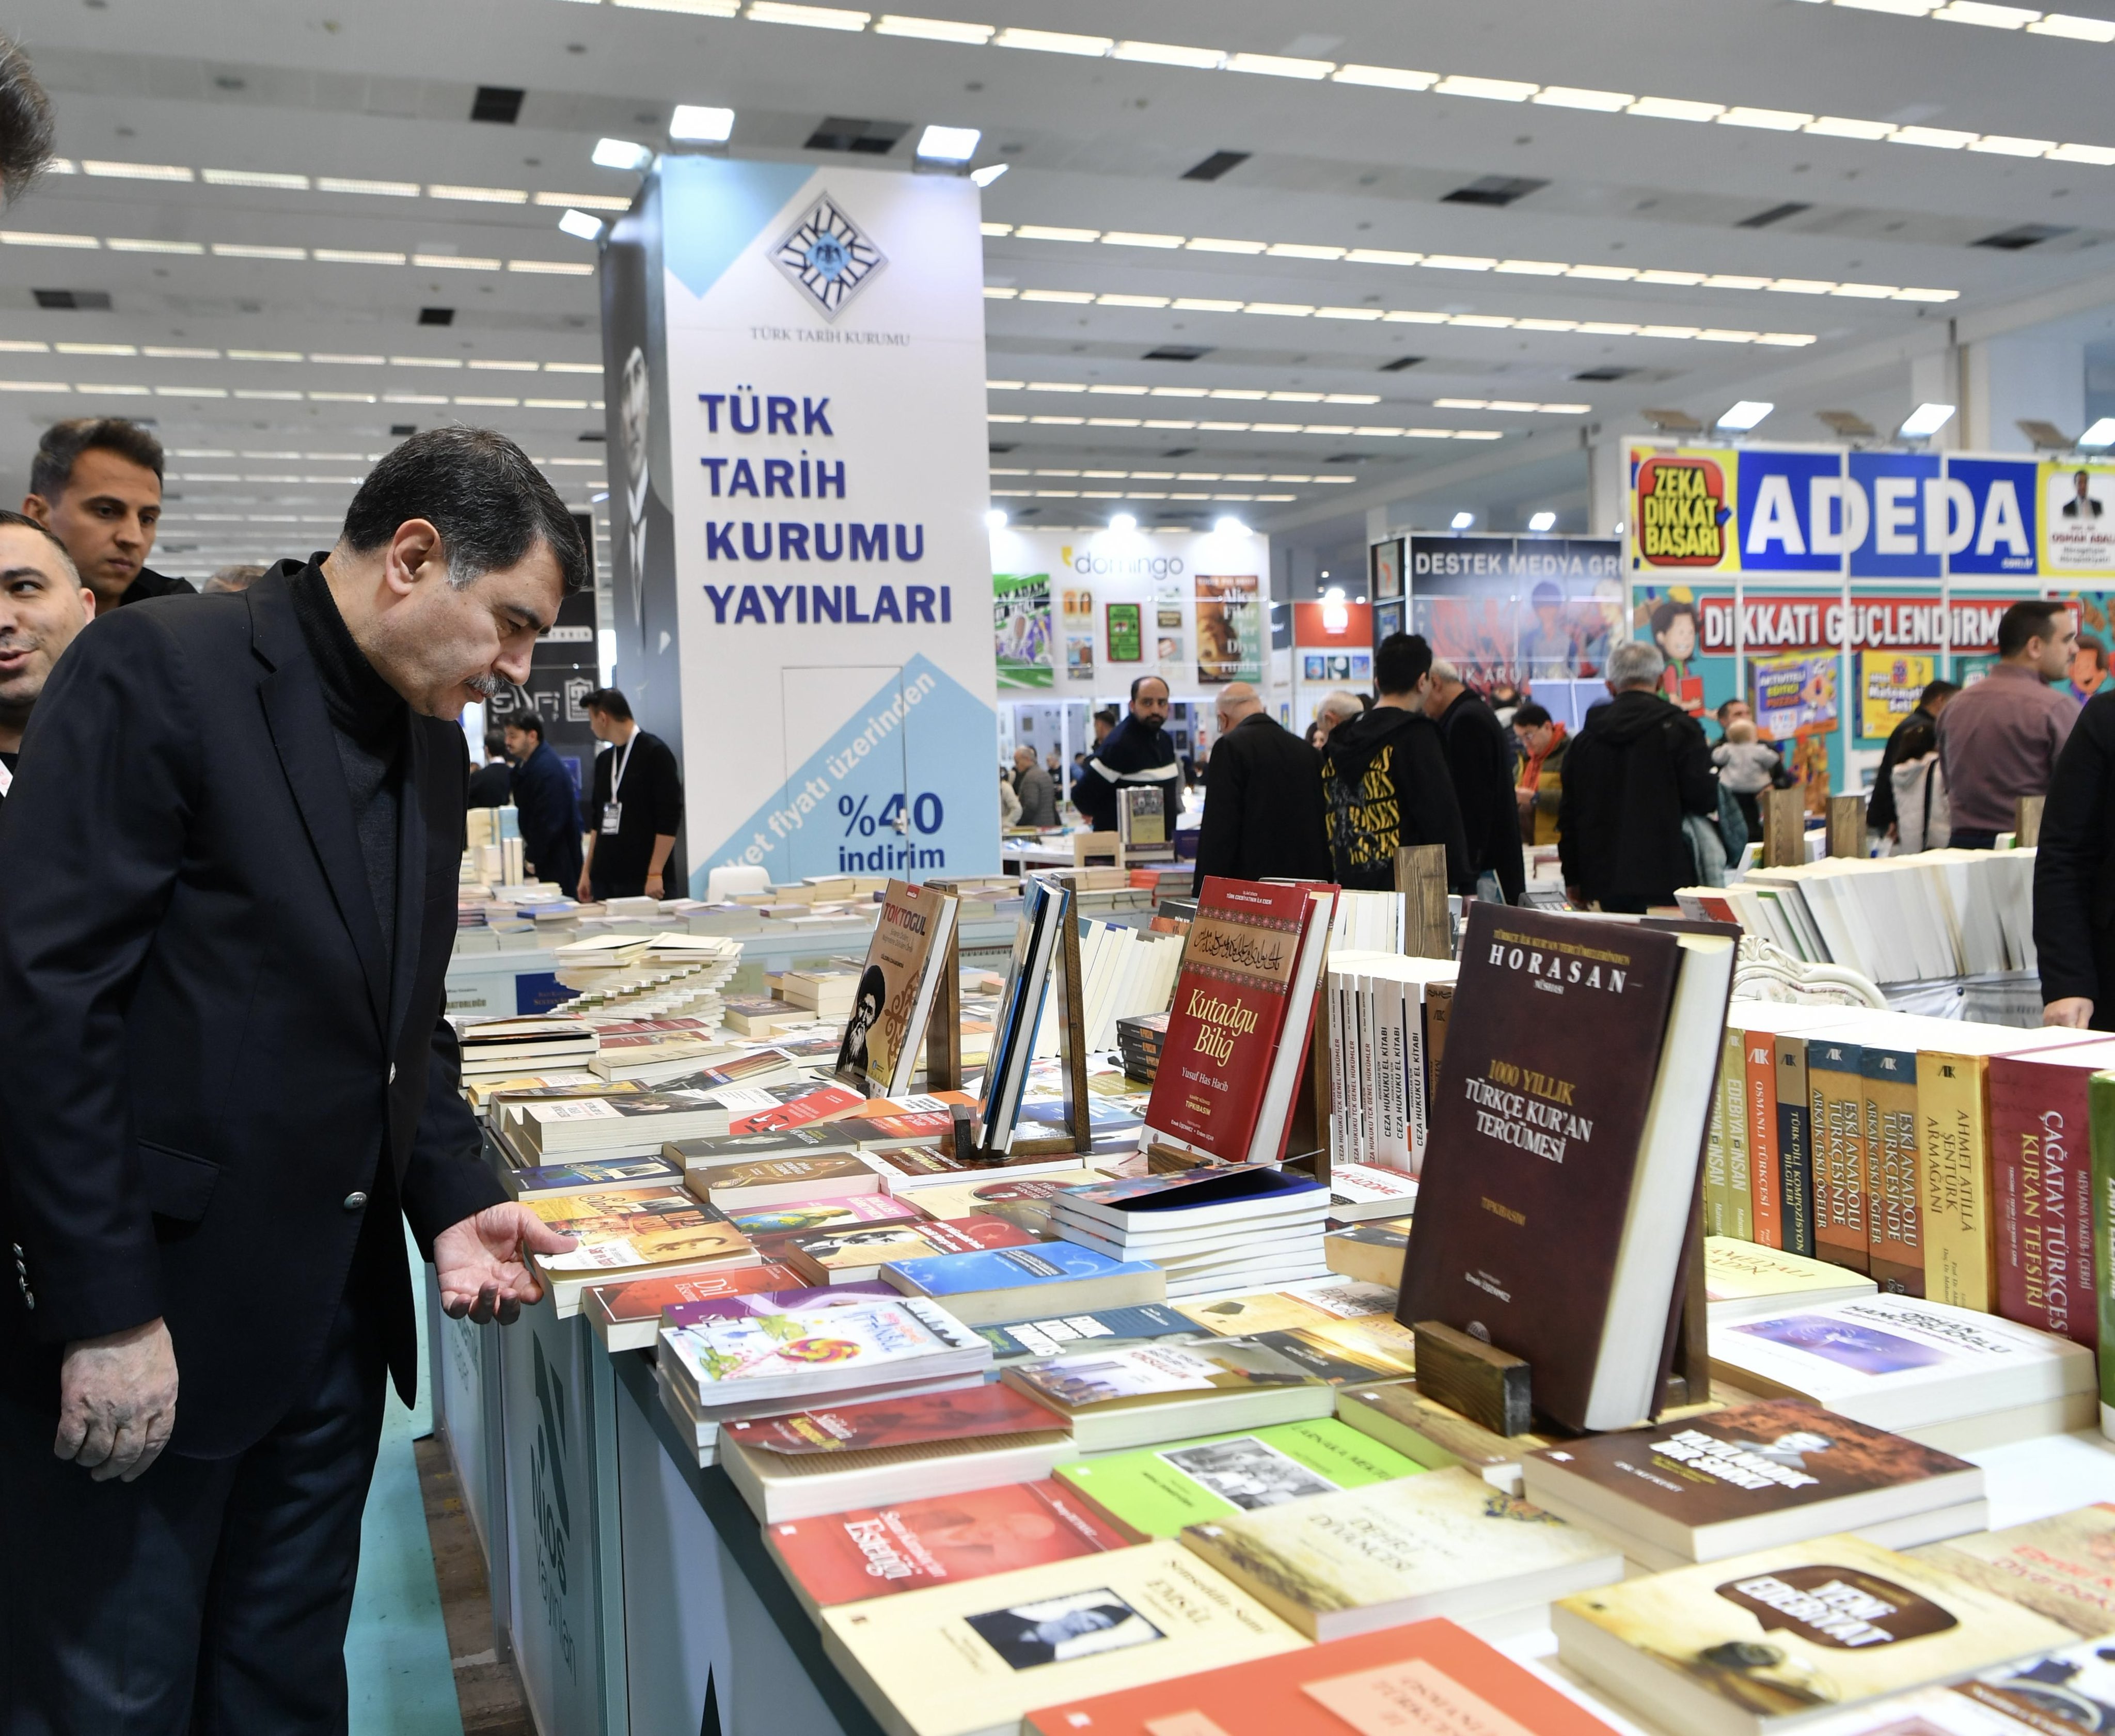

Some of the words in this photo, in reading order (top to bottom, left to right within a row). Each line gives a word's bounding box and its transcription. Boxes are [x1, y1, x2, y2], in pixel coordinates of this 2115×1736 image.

[751, 325, 791, 341] TÜRK
[796, 327, 842, 343] TARİH
[845, 331, 911, 346] KURUMU
[699, 385, 833, 436] TÜRK
[700, 450, 846, 499] TARİH
[1654, 467, 1706, 499] ZEKA
[1644, 493, 1718, 528] DİKKAT
[1746, 475, 2030, 556] ADEDA
[706, 522, 924, 562] KURUMU
[1646, 525, 1720, 558] BAŞARI
[1075, 553, 1183, 580] domingo
[1415, 552, 1502, 575] DESTEK
[1508, 554, 1584, 576] MEDYA
[703, 586, 952, 624] YAYINLARI
[1705, 605, 1819, 648] DİKKATİ
[1826, 605, 2006, 649] GÜÇLENDİRM
[768, 776, 831, 839] fiyatı
[825, 671, 937, 780] üzerinden
[838, 792, 944, 838] %40
[839, 843, 945, 873] indirim
[882, 902, 926, 936] TOKTOGUL
[1488, 943, 1628, 993] HORASAN
[1185, 988, 1260, 1037] Kutadgu
[1193, 1024, 1235, 1068] Bilig
[1364, 1043, 1372, 1082] HÜKÜMLER
[1380, 1027, 1388, 1056] KİTABI
[1181, 1066, 1200, 1081] Yusuf
[1199, 1072, 1211, 1085] Has
[1211, 1078, 1228, 1092] Hacib
[1382, 1059, 1389, 1070] EL
[1394, 1060, 1401, 1071] EL
[1414, 1066, 1420, 1077] EL
[1487, 1059, 1520, 1087] 1000
[1523, 1069, 1576, 1107] YILLIK
[1186, 1100, 1211, 1116] TIPKIBASIM
[1382, 1072, 1391, 1112] HUKUKU
[1395, 1073, 1403, 1113] HUKUKU
[1414, 1079, 1423, 1120] HUKUKU
[1464, 1077, 1523, 1119] TÜRKÇE
[1756, 1080, 1766, 1139] OSMANLI
[1812, 1088, 1824, 1137] ARKAİK
[1383, 1114, 1392, 1138] CEZA
[1415, 1123, 1424, 1146] CEZA
[1475, 1110, 1567, 1164] TERCÜMESİ
[1791, 1111, 1801, 1144] TÜRK
[1843, 1100, 1858, 1139] ESKİ
[1867, 1100, 1879, 1149] ARKAİK
[1898, 1113, 1914, 1151] ESKİ
[1792, 1144, 1802, 1166] DİLİ
[1814, 1138, 1826, 1177] (ESKİ)
[1829, 1101, 1846, 1226] TÜRKÇESİNDE
[1956, 1109, 1972, 1175] AHMET
[1757, 1144, 1771, 1207] TÜRKÇESİ
[1784, 1153, 1796, 1207] BİLGİLERİ
[1844, 1142, 1861, 1232] ANADOLU
[1868, 1151, 1881, 1189] (ESKİ)
[1883, 1112, 1901, 1242] TÜRKÇESİNDE
[1927, 1116, 1943, 1214] ARMAĞANI
[1940, 1131, 1958, 1211] ŞENTÜRK
[2021, 1133, 2041, 1220] KUR'AN
[2038, 1110, 2069, 1220] ÇAĞATAY
[1793, 1167, 1805, 1253] KOMPOZİSYON
[1816, 1177, 1828, 1229] ÖĞELER
[1870, 1191, 1882, 1244] ÖĞELER
[1900, 1154, 1917, 1249] ANADOLU
[2023, 1225, 2046, 1310] TEFSİRİ
[2045, 1225, 2071, 1340] TÜRKÇES
[1670, 1429, 1820, 1490] YAZILMADIK
[1733, 1575, 1895, 1647] EDEBİYAT
[1807, 1579, 1898, 1622] YENİ
